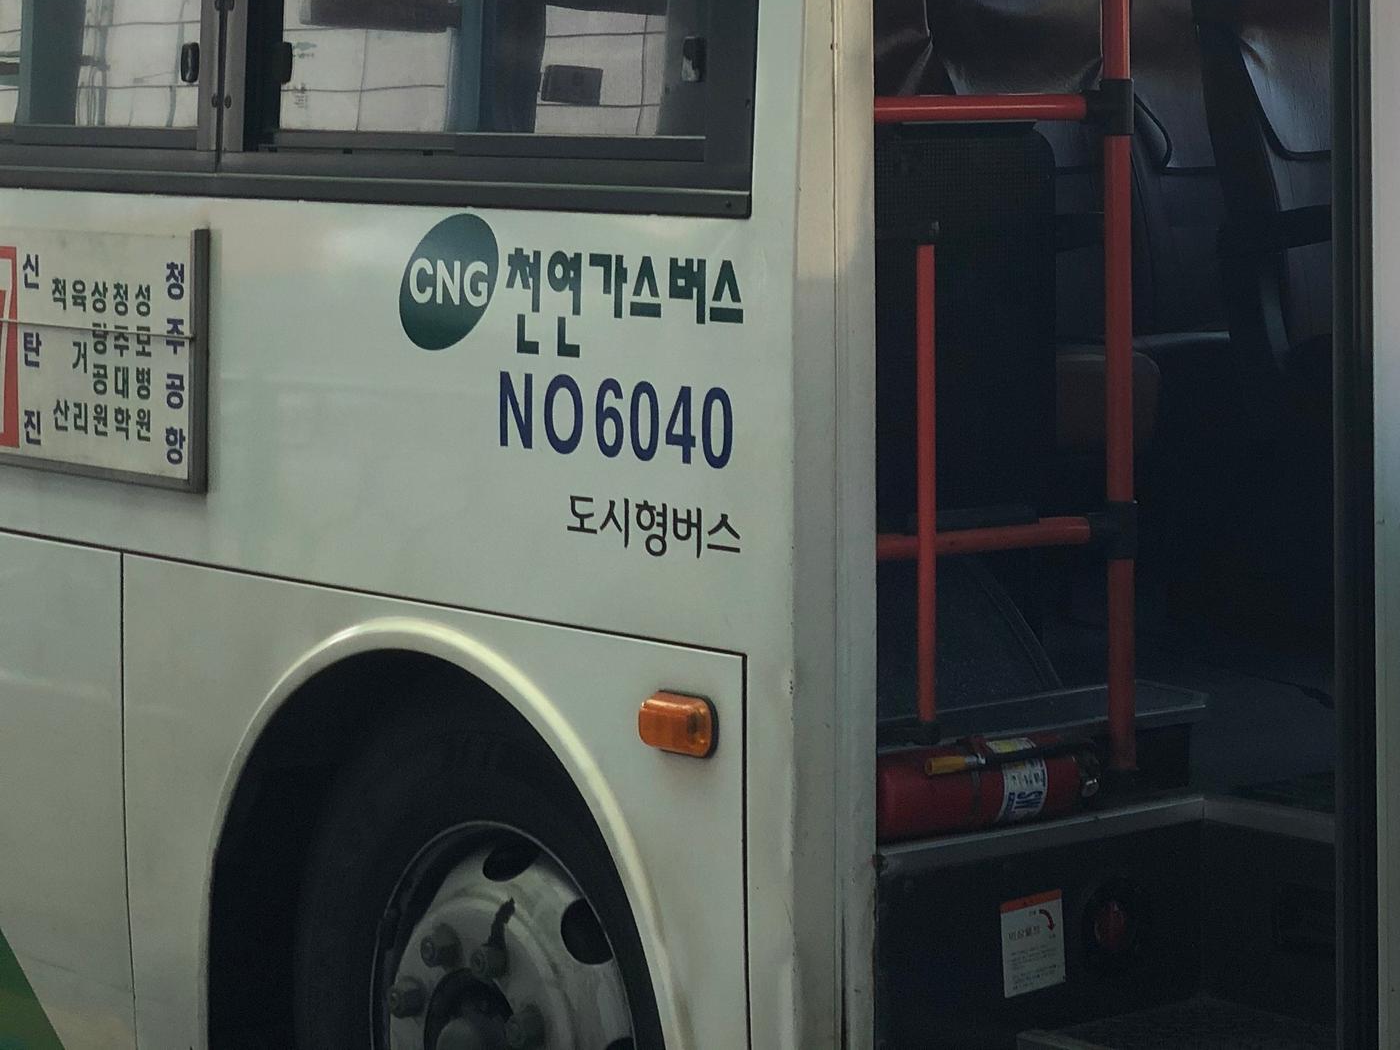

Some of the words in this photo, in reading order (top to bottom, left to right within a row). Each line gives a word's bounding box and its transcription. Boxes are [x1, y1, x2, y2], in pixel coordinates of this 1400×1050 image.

[409, 257, 490, 308] CNG
[505, 247, 744, 359] 천연가스버스
[566, 495, 742, 559] 도시형버스
